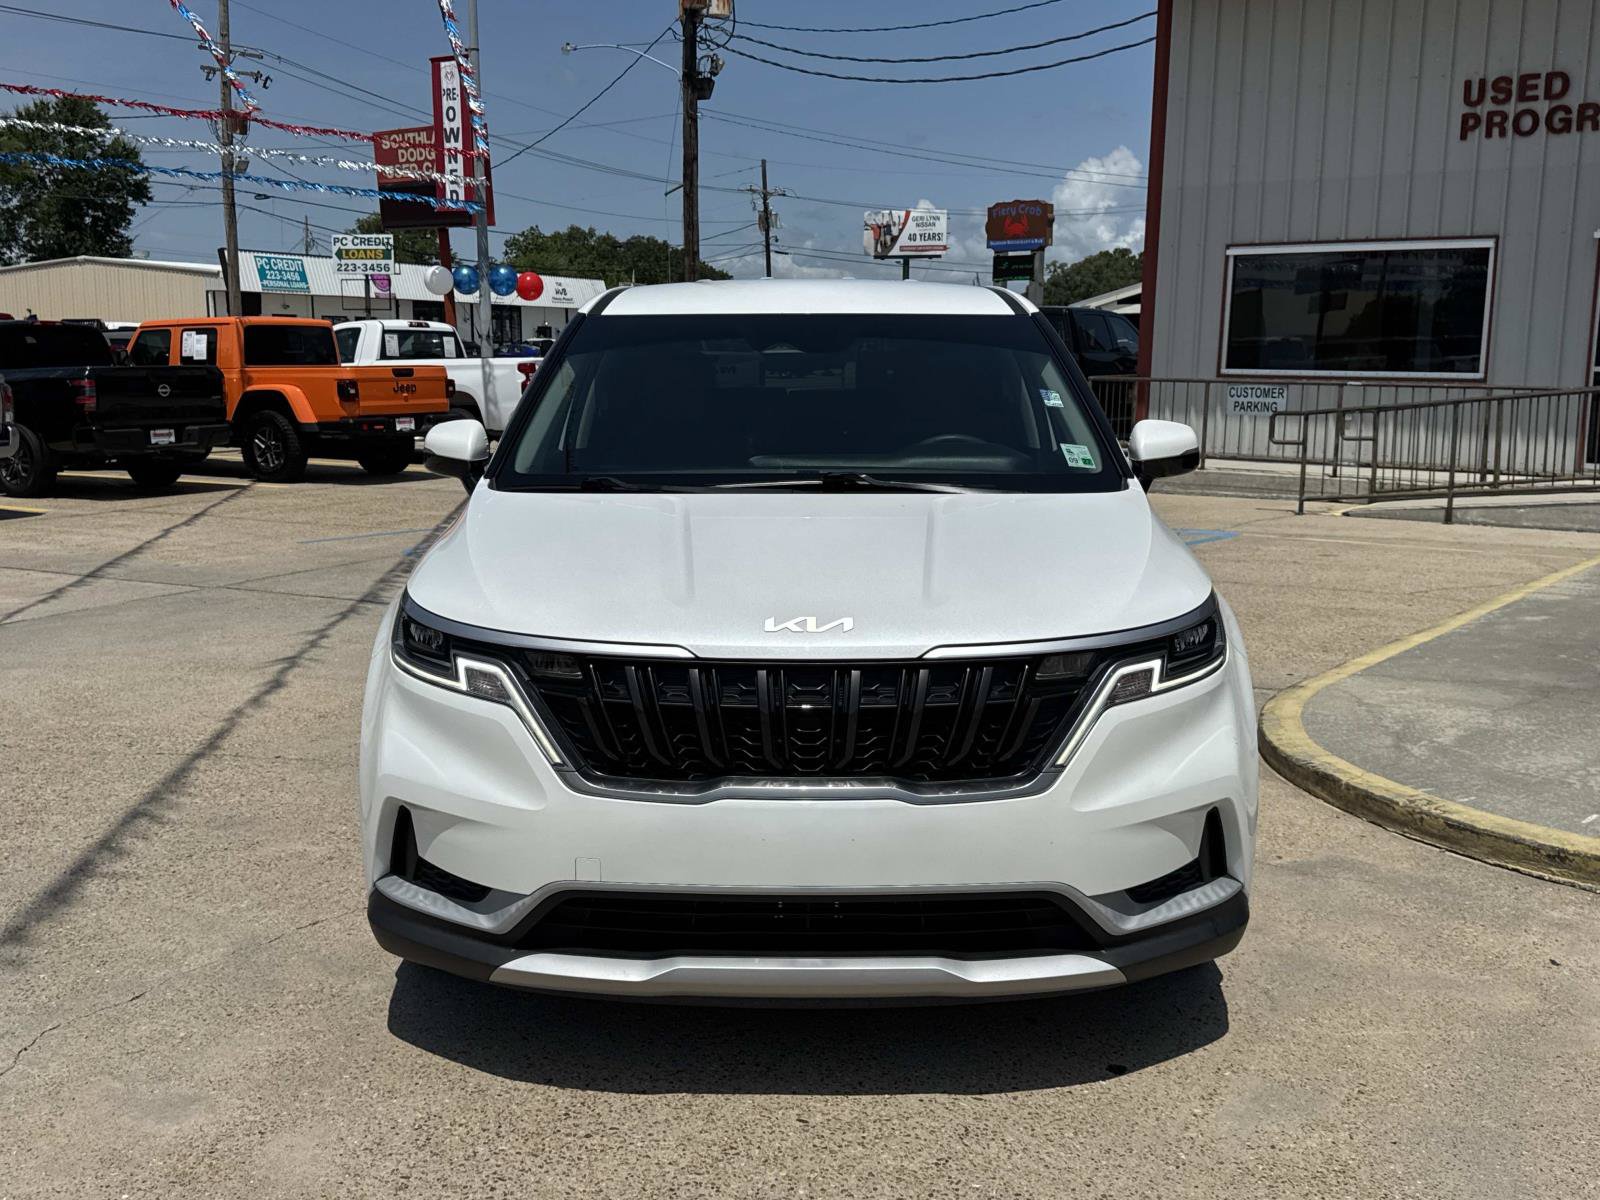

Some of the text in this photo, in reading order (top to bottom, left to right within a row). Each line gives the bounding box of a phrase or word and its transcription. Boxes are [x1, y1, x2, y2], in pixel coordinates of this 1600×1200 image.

[1463, 71, 1570, 107] USED
[1460, 103, 1600, 140] PROGR
[333, 236, 392, 247] PC CREDIT
[908, 233, 944, 242] 40 YEARS!
[342, 250, 384, 259] LOANS
[256, 257, 304, 272] PC CREDIT
[392, 381, 417, 394] Jeep
[1229, 387, 1285, 399] CUSTOMER
[1233, 401, 1278, 412] PARKING
